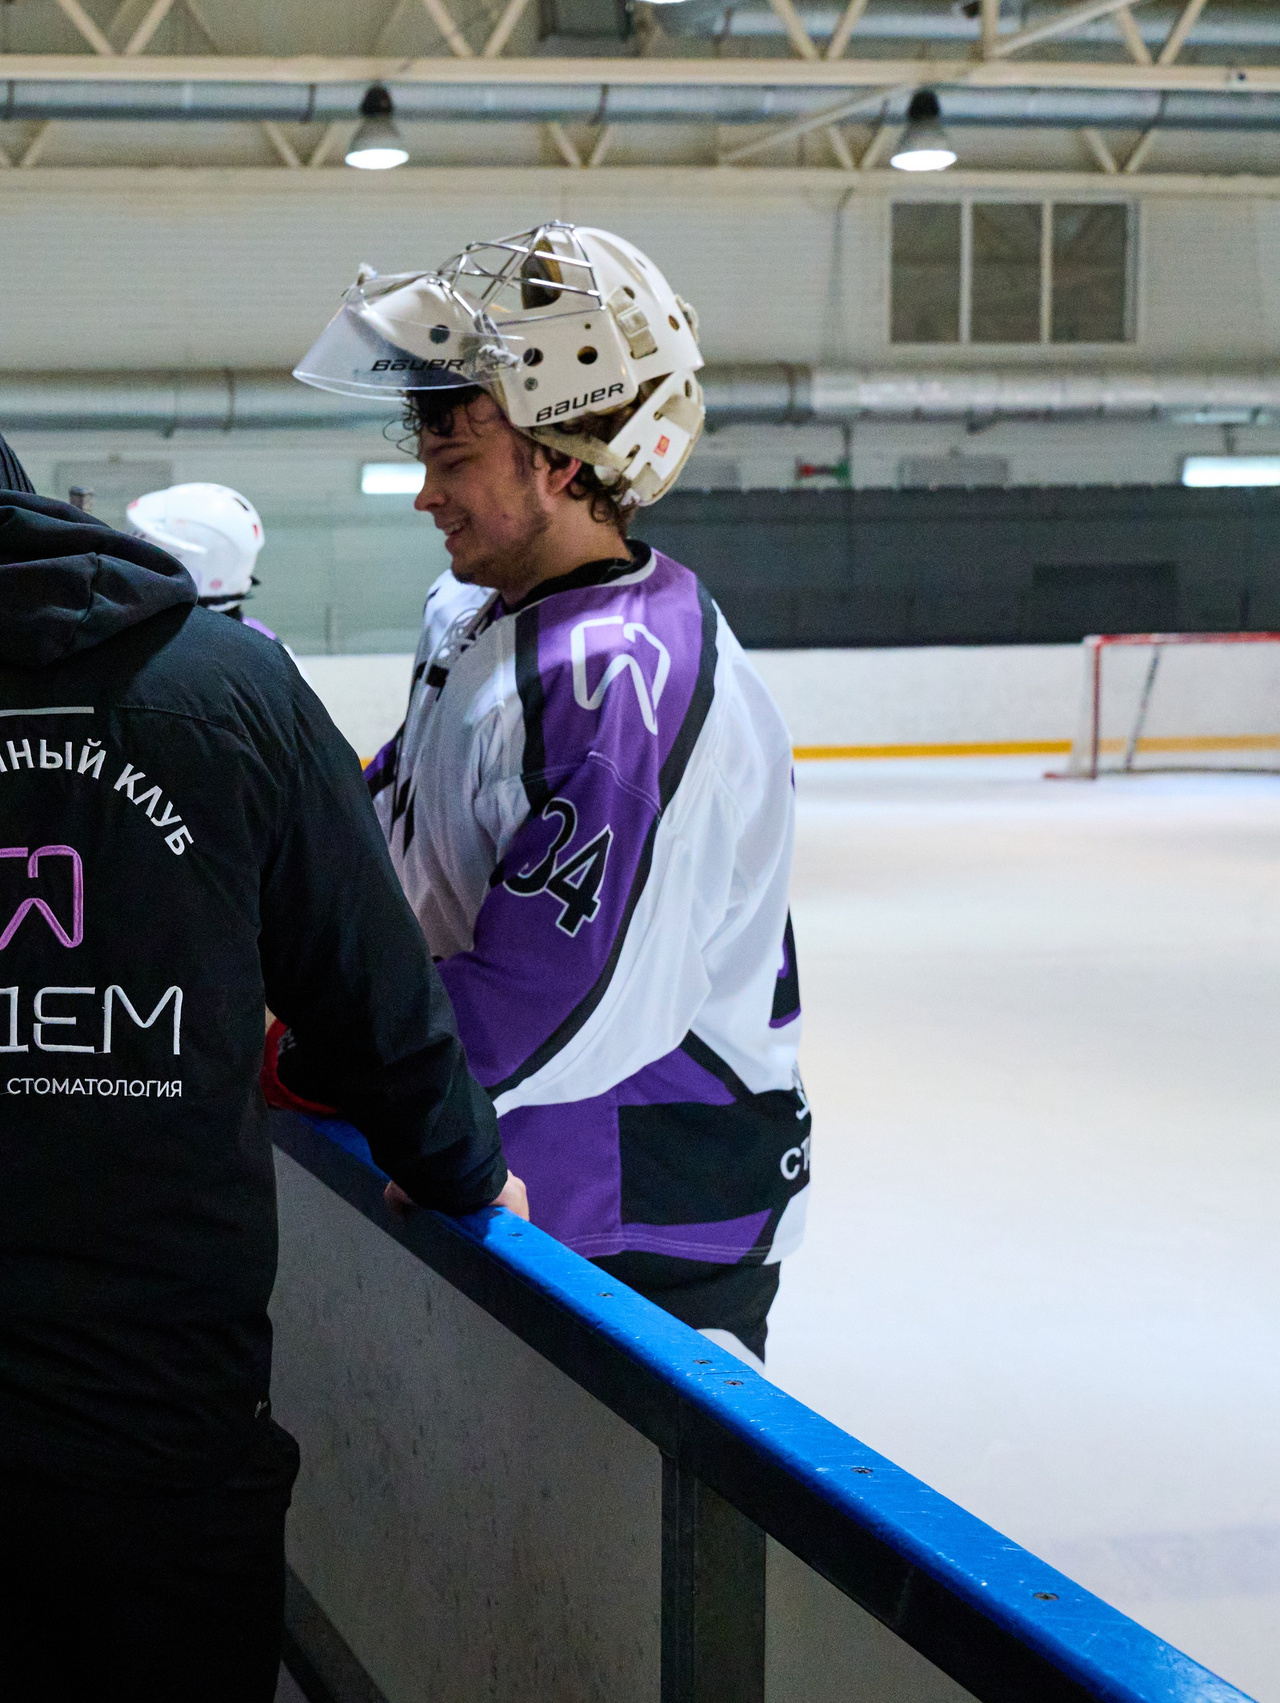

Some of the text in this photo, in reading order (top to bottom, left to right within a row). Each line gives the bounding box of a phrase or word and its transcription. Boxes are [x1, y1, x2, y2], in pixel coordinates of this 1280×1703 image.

[371, 358, 465, 372] BAUER
[535, 382, 625, 423] BAUER
[113, 763, 194, 856] КЛУБ
[502, 797, 614, 938] 34
[7, 1078, 182, 1098] СТОМАТОЛОГИЯ
